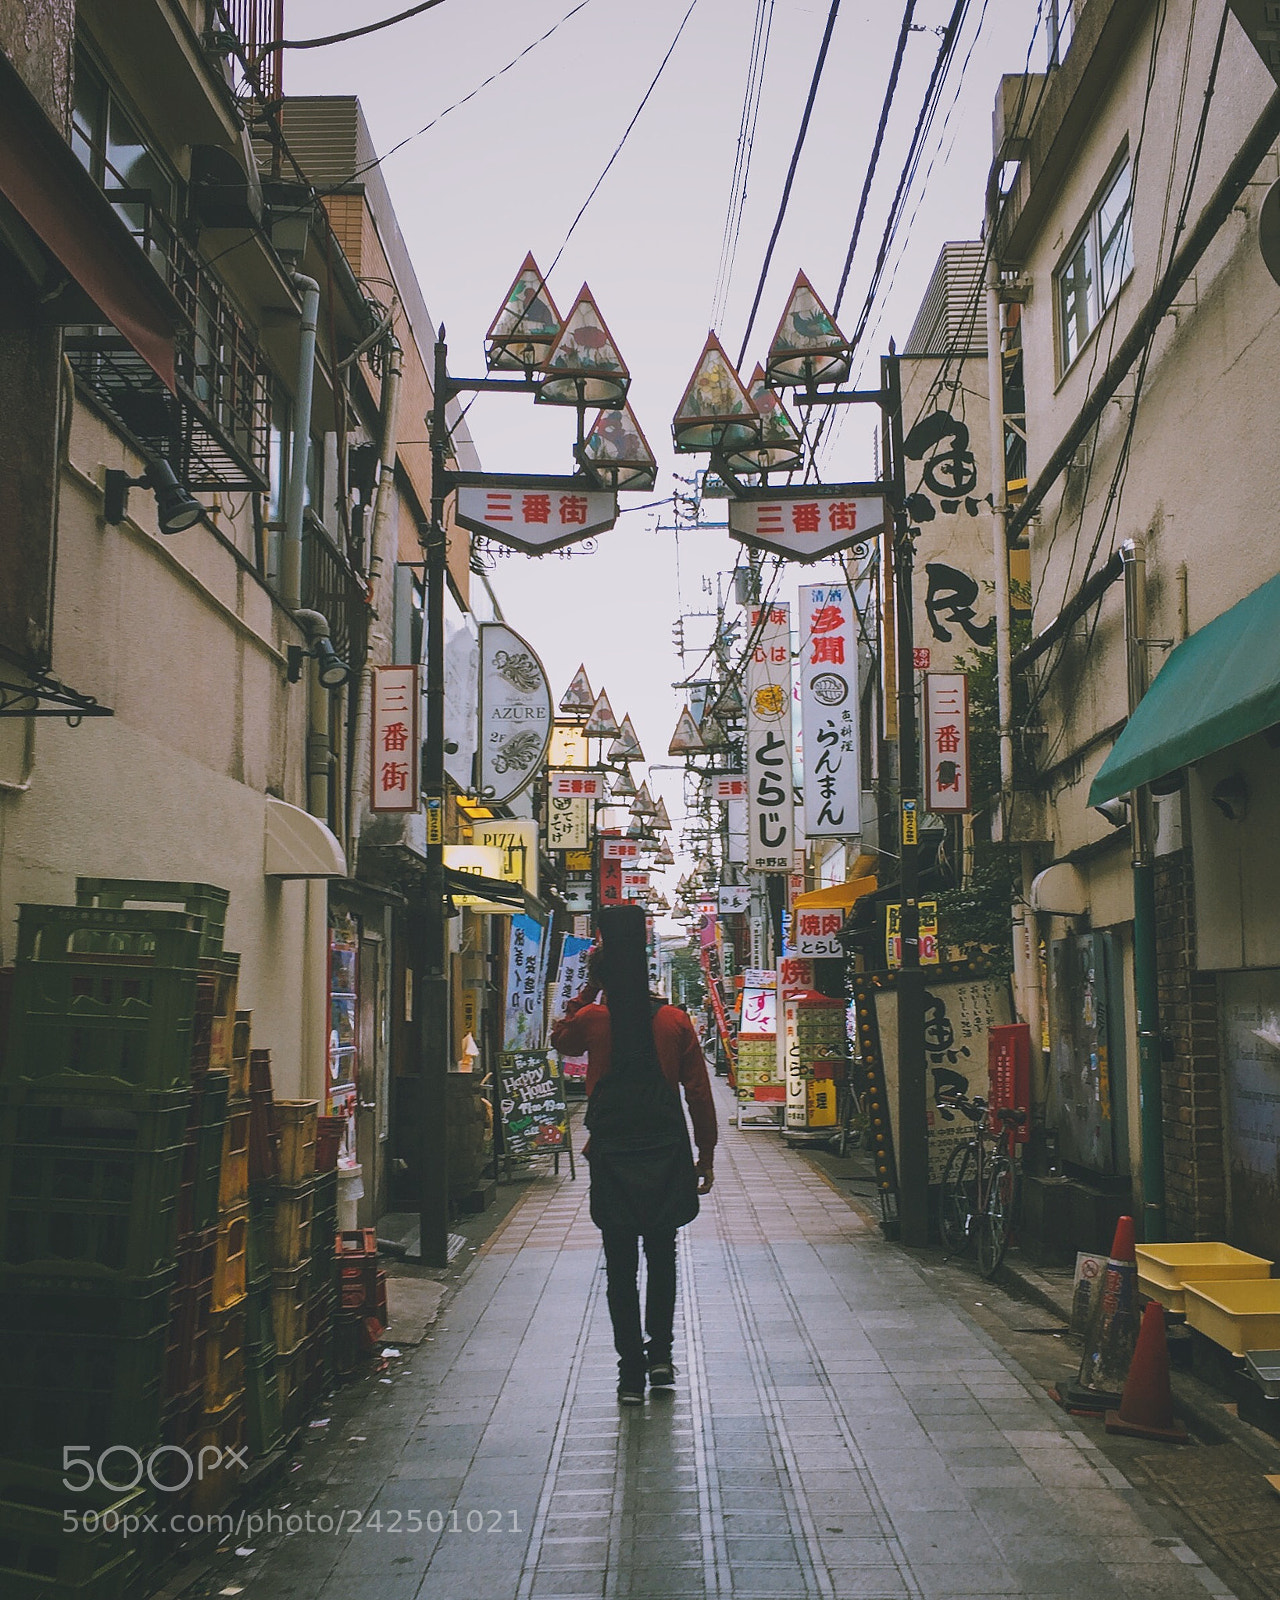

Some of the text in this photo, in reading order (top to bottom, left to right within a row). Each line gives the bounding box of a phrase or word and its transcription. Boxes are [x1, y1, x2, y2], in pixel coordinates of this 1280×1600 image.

[484, 493, 588, 525] 三番街
[756, 501, 857, 534] 三番街
[810, 605, 846, 665] 多聞
[492, 707, 546, 719] AZURE
[381, 685, 408, 792] 三番街
[558, 780, 596, 793] 三番街
[814, 720, 845, 826] らんまん
[755, 731, 787, 848] とらじ
[755, 858, 788, 868] 中野店
[800, 914, 842, 937] 焼肉
[801, 941, 841, 955] とらじ
[503, 1066, 544, 1093] Happy
[519, 1080, 555, 1102] Hour
